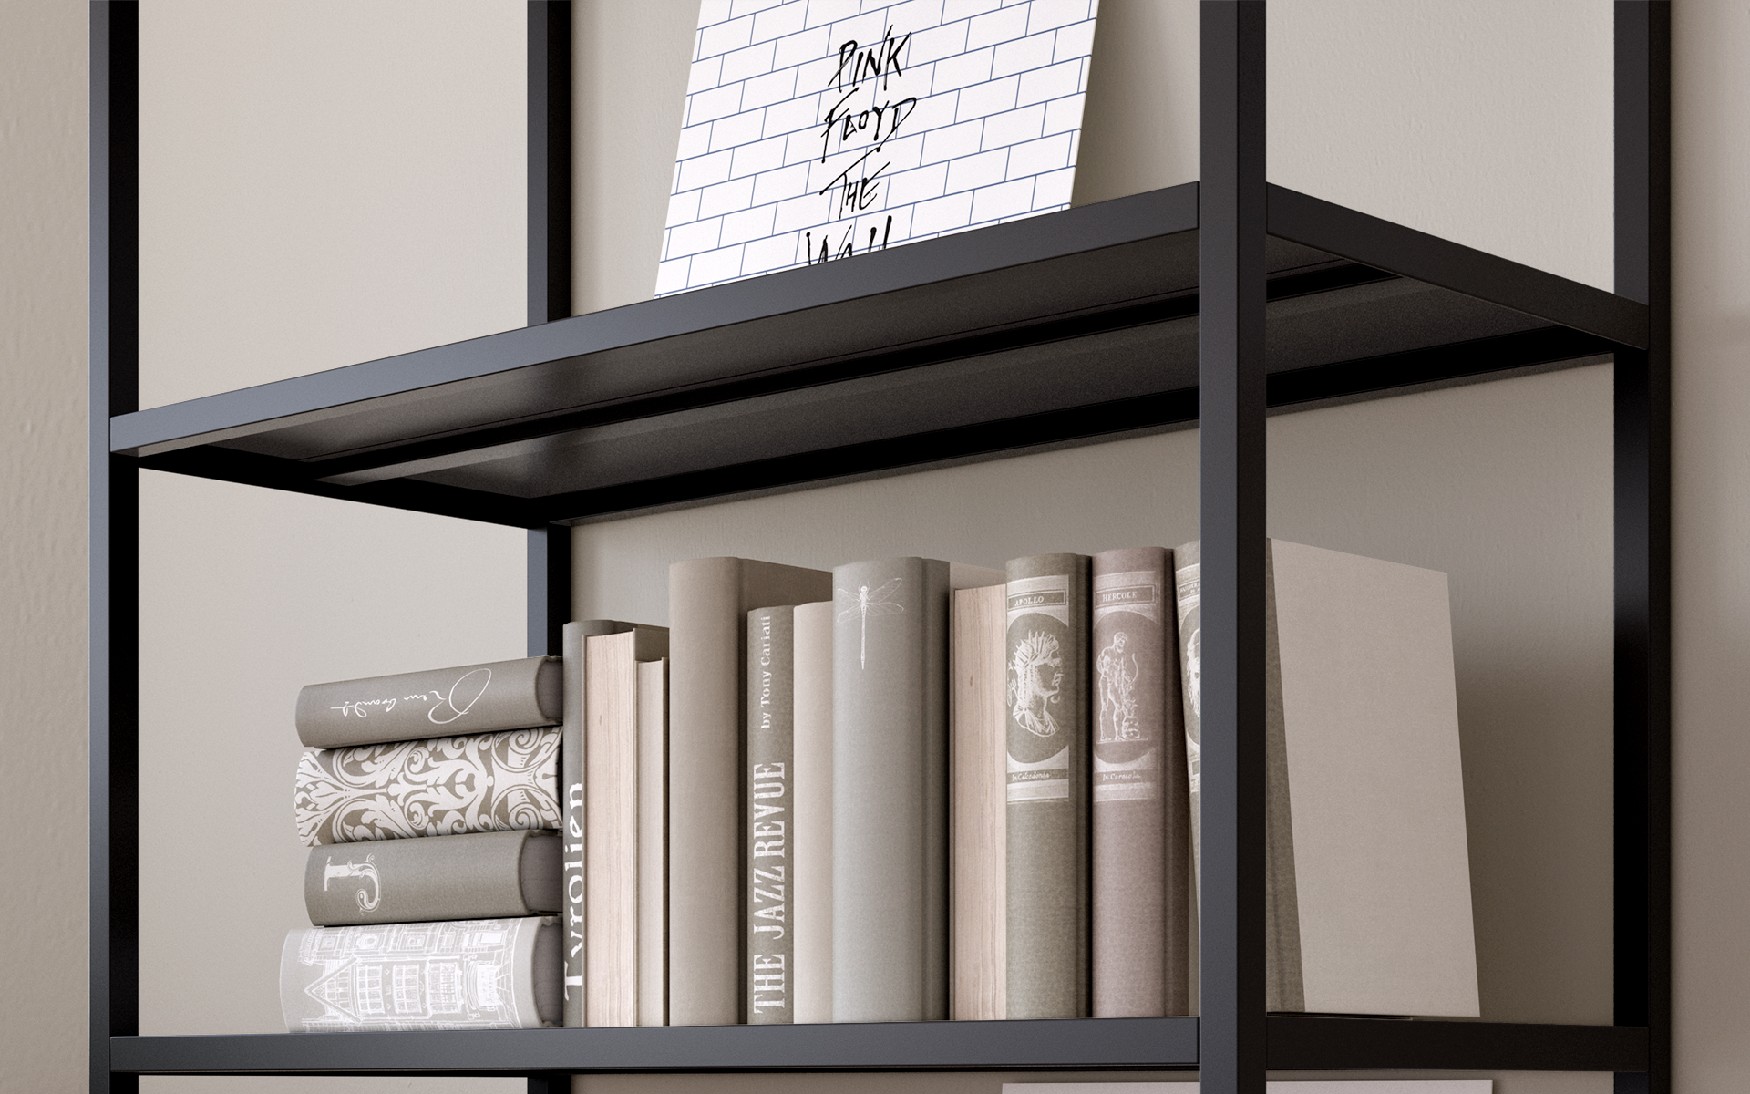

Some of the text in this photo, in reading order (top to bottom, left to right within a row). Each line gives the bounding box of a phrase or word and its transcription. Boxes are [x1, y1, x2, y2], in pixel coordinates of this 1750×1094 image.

[828, 24, 912, 93] PINK
[820, 88, 918, 163] FLOYD
[819, 150, 891, 219] THE
[760, 670, 772, 708] Tony
[760, 712, 772, 729] by
[753, 762, 785, 1014] THE JAZZ REVUE
